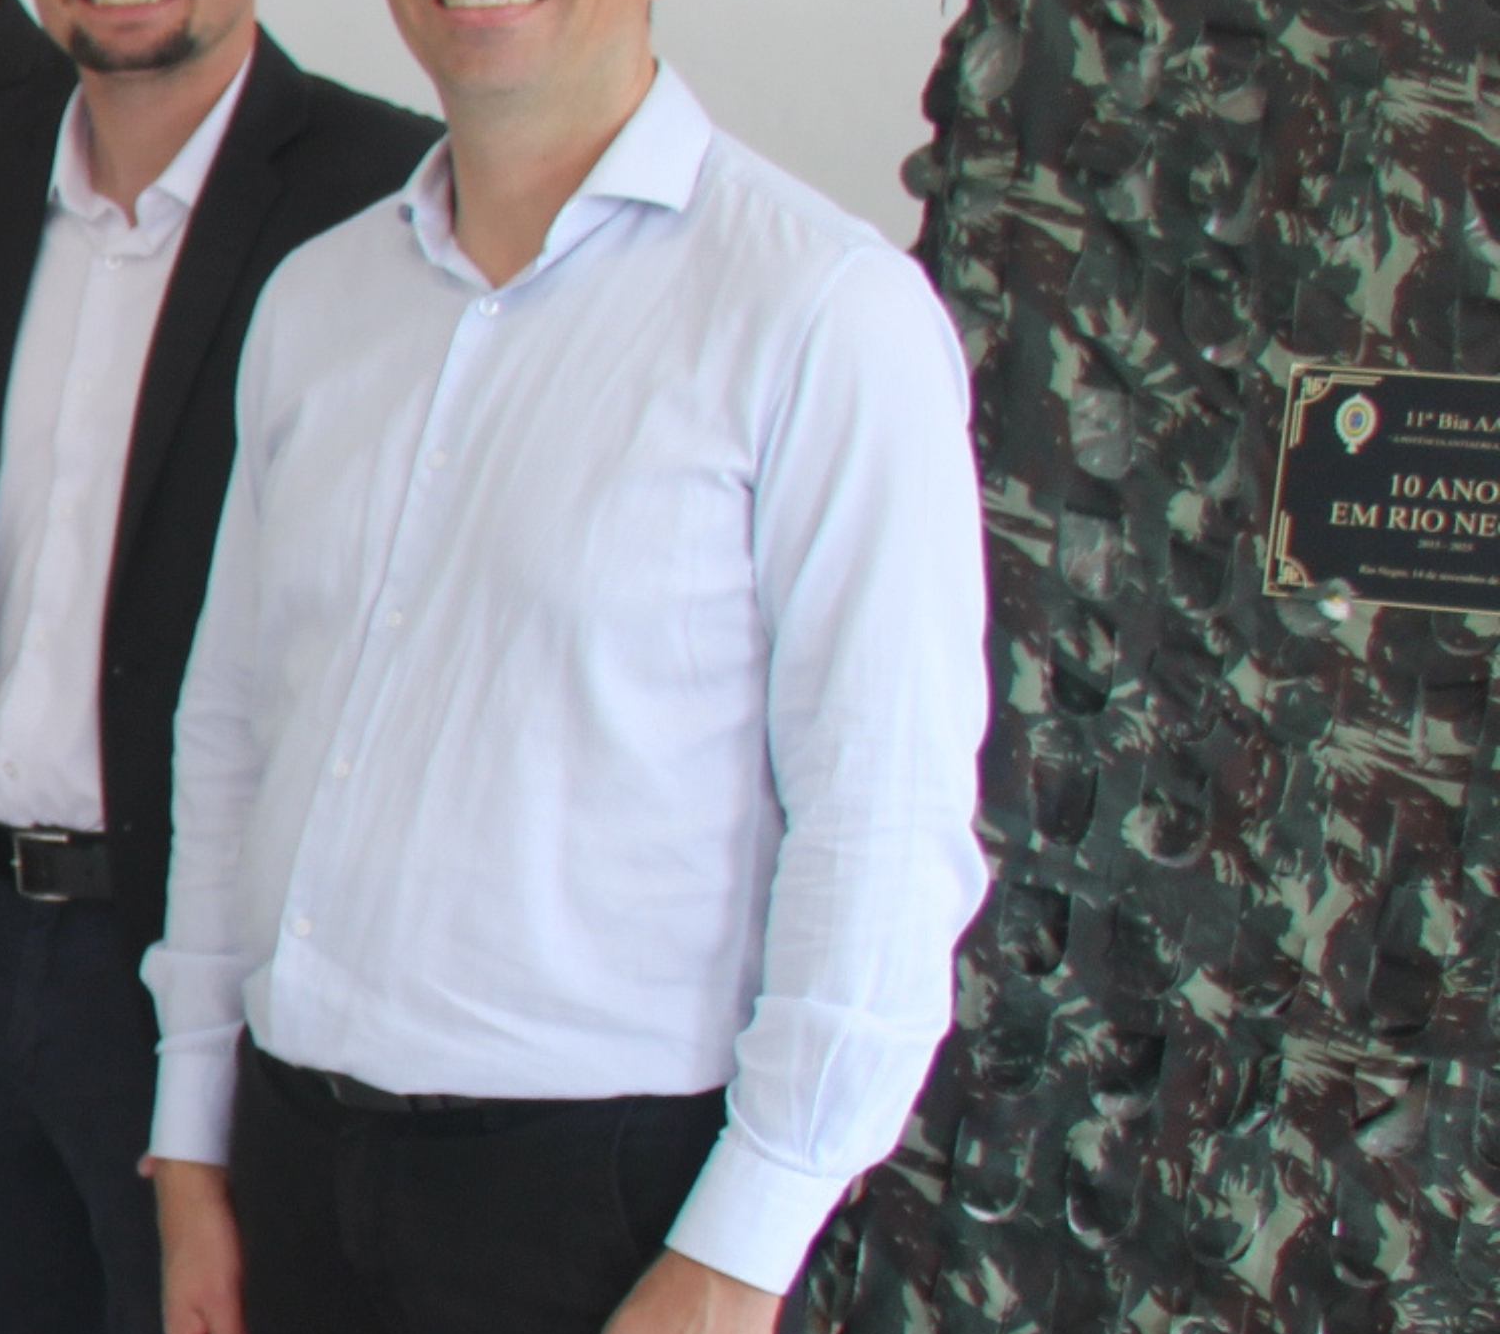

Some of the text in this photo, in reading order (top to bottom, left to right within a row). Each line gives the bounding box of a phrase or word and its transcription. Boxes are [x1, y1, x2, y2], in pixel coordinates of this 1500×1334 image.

[1438, 413, 1473, 431] Bia
[1390, 473, 1424, 498] 10
[1329, 501, 1500, 538] EM RIO NE
